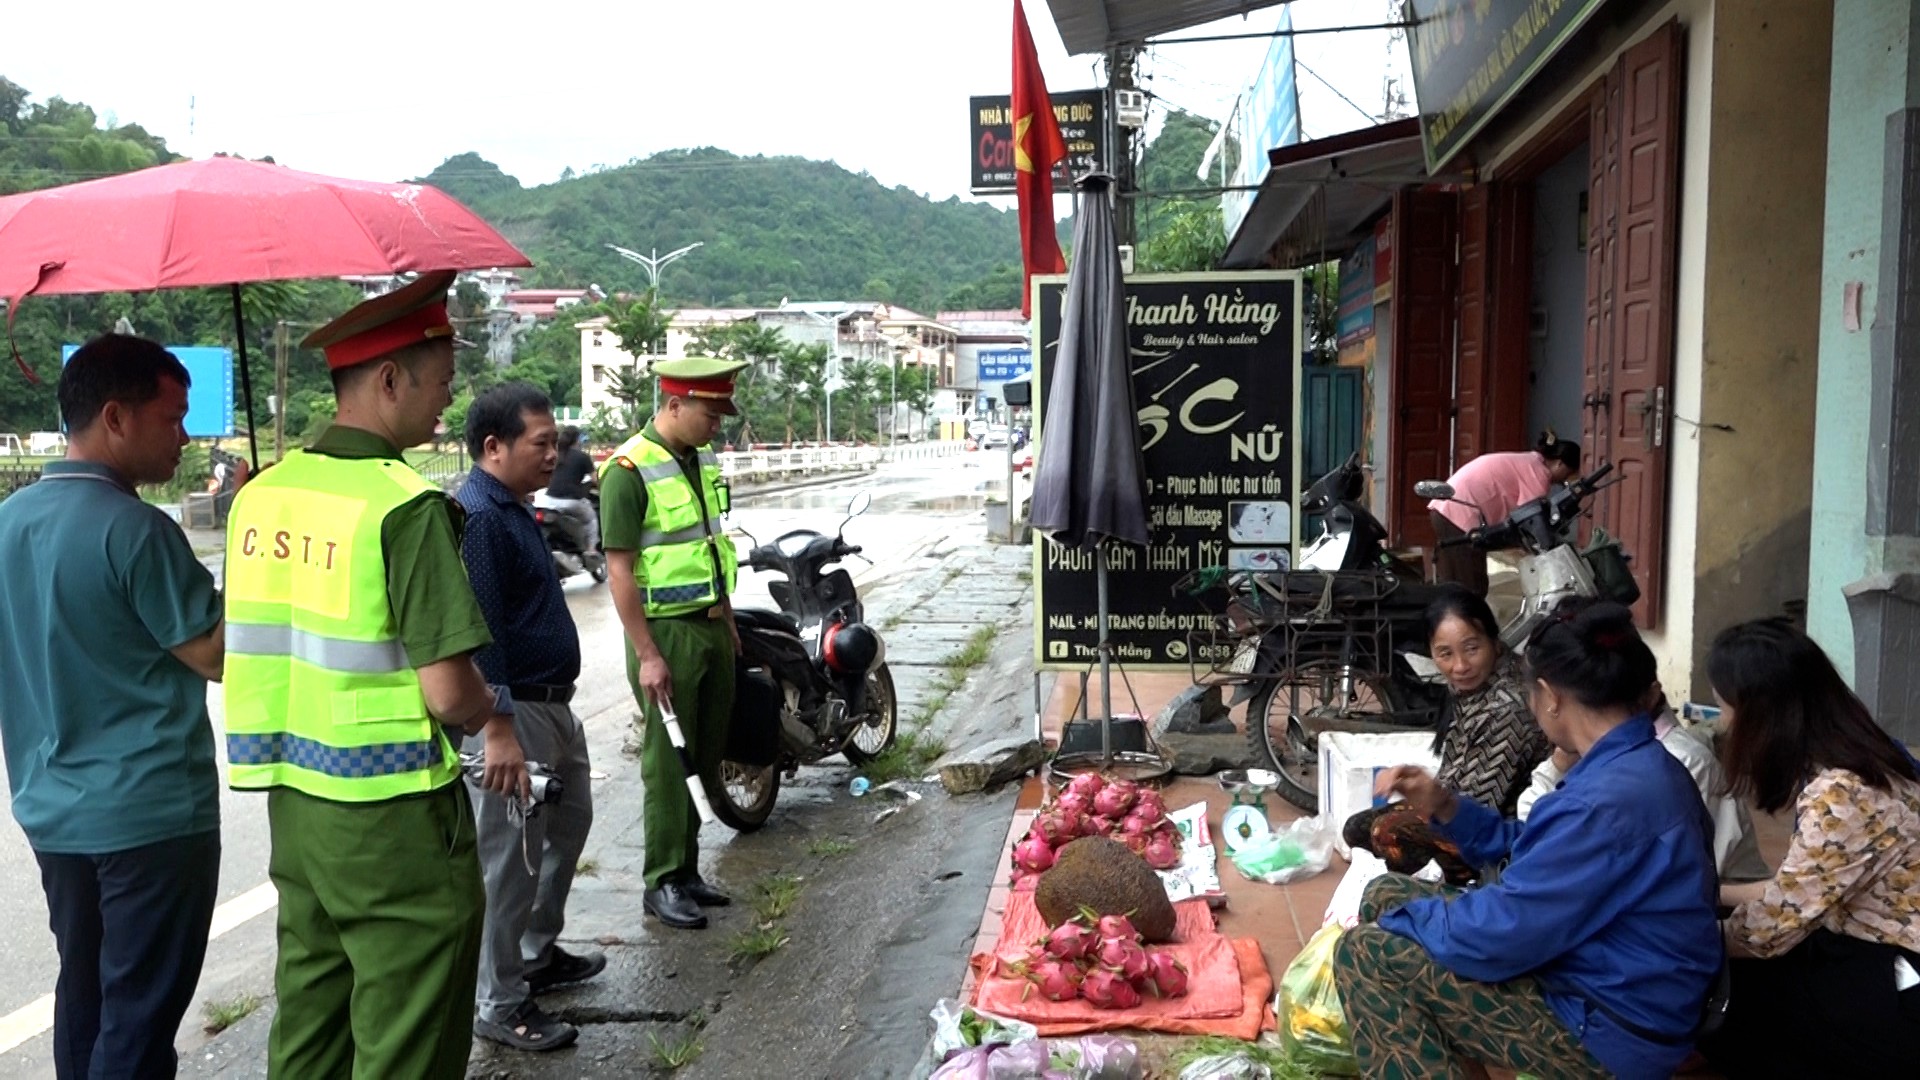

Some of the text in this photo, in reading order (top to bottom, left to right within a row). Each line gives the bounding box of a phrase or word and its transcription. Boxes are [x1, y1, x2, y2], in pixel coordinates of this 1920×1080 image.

[980, 105, 1003, 126] NHÀ
[1126, 287, 1281, 336] hanh Hằng
[1143, 332, 1259, 350] Beauty & Hair salon
[1231, 424, 1283, 462] NỮ
[1167, 476, 1197, 499] Phục
[1200, 471, 1218, 494] hồi
[1221, 474, 1240, 494] tóc
[1244, 475, 1260, 494] hư
[1262, 470, 1282, 494] tổn
[1184, 505, 1222, 531] Massage
[1198, 539, 1223, 570] MỸ
[1049, 614, 1076, 629] NAIL
[1107, 614, 1145, 629] TRANG
[1148, 607, 1176, 630] ĐIỂM
